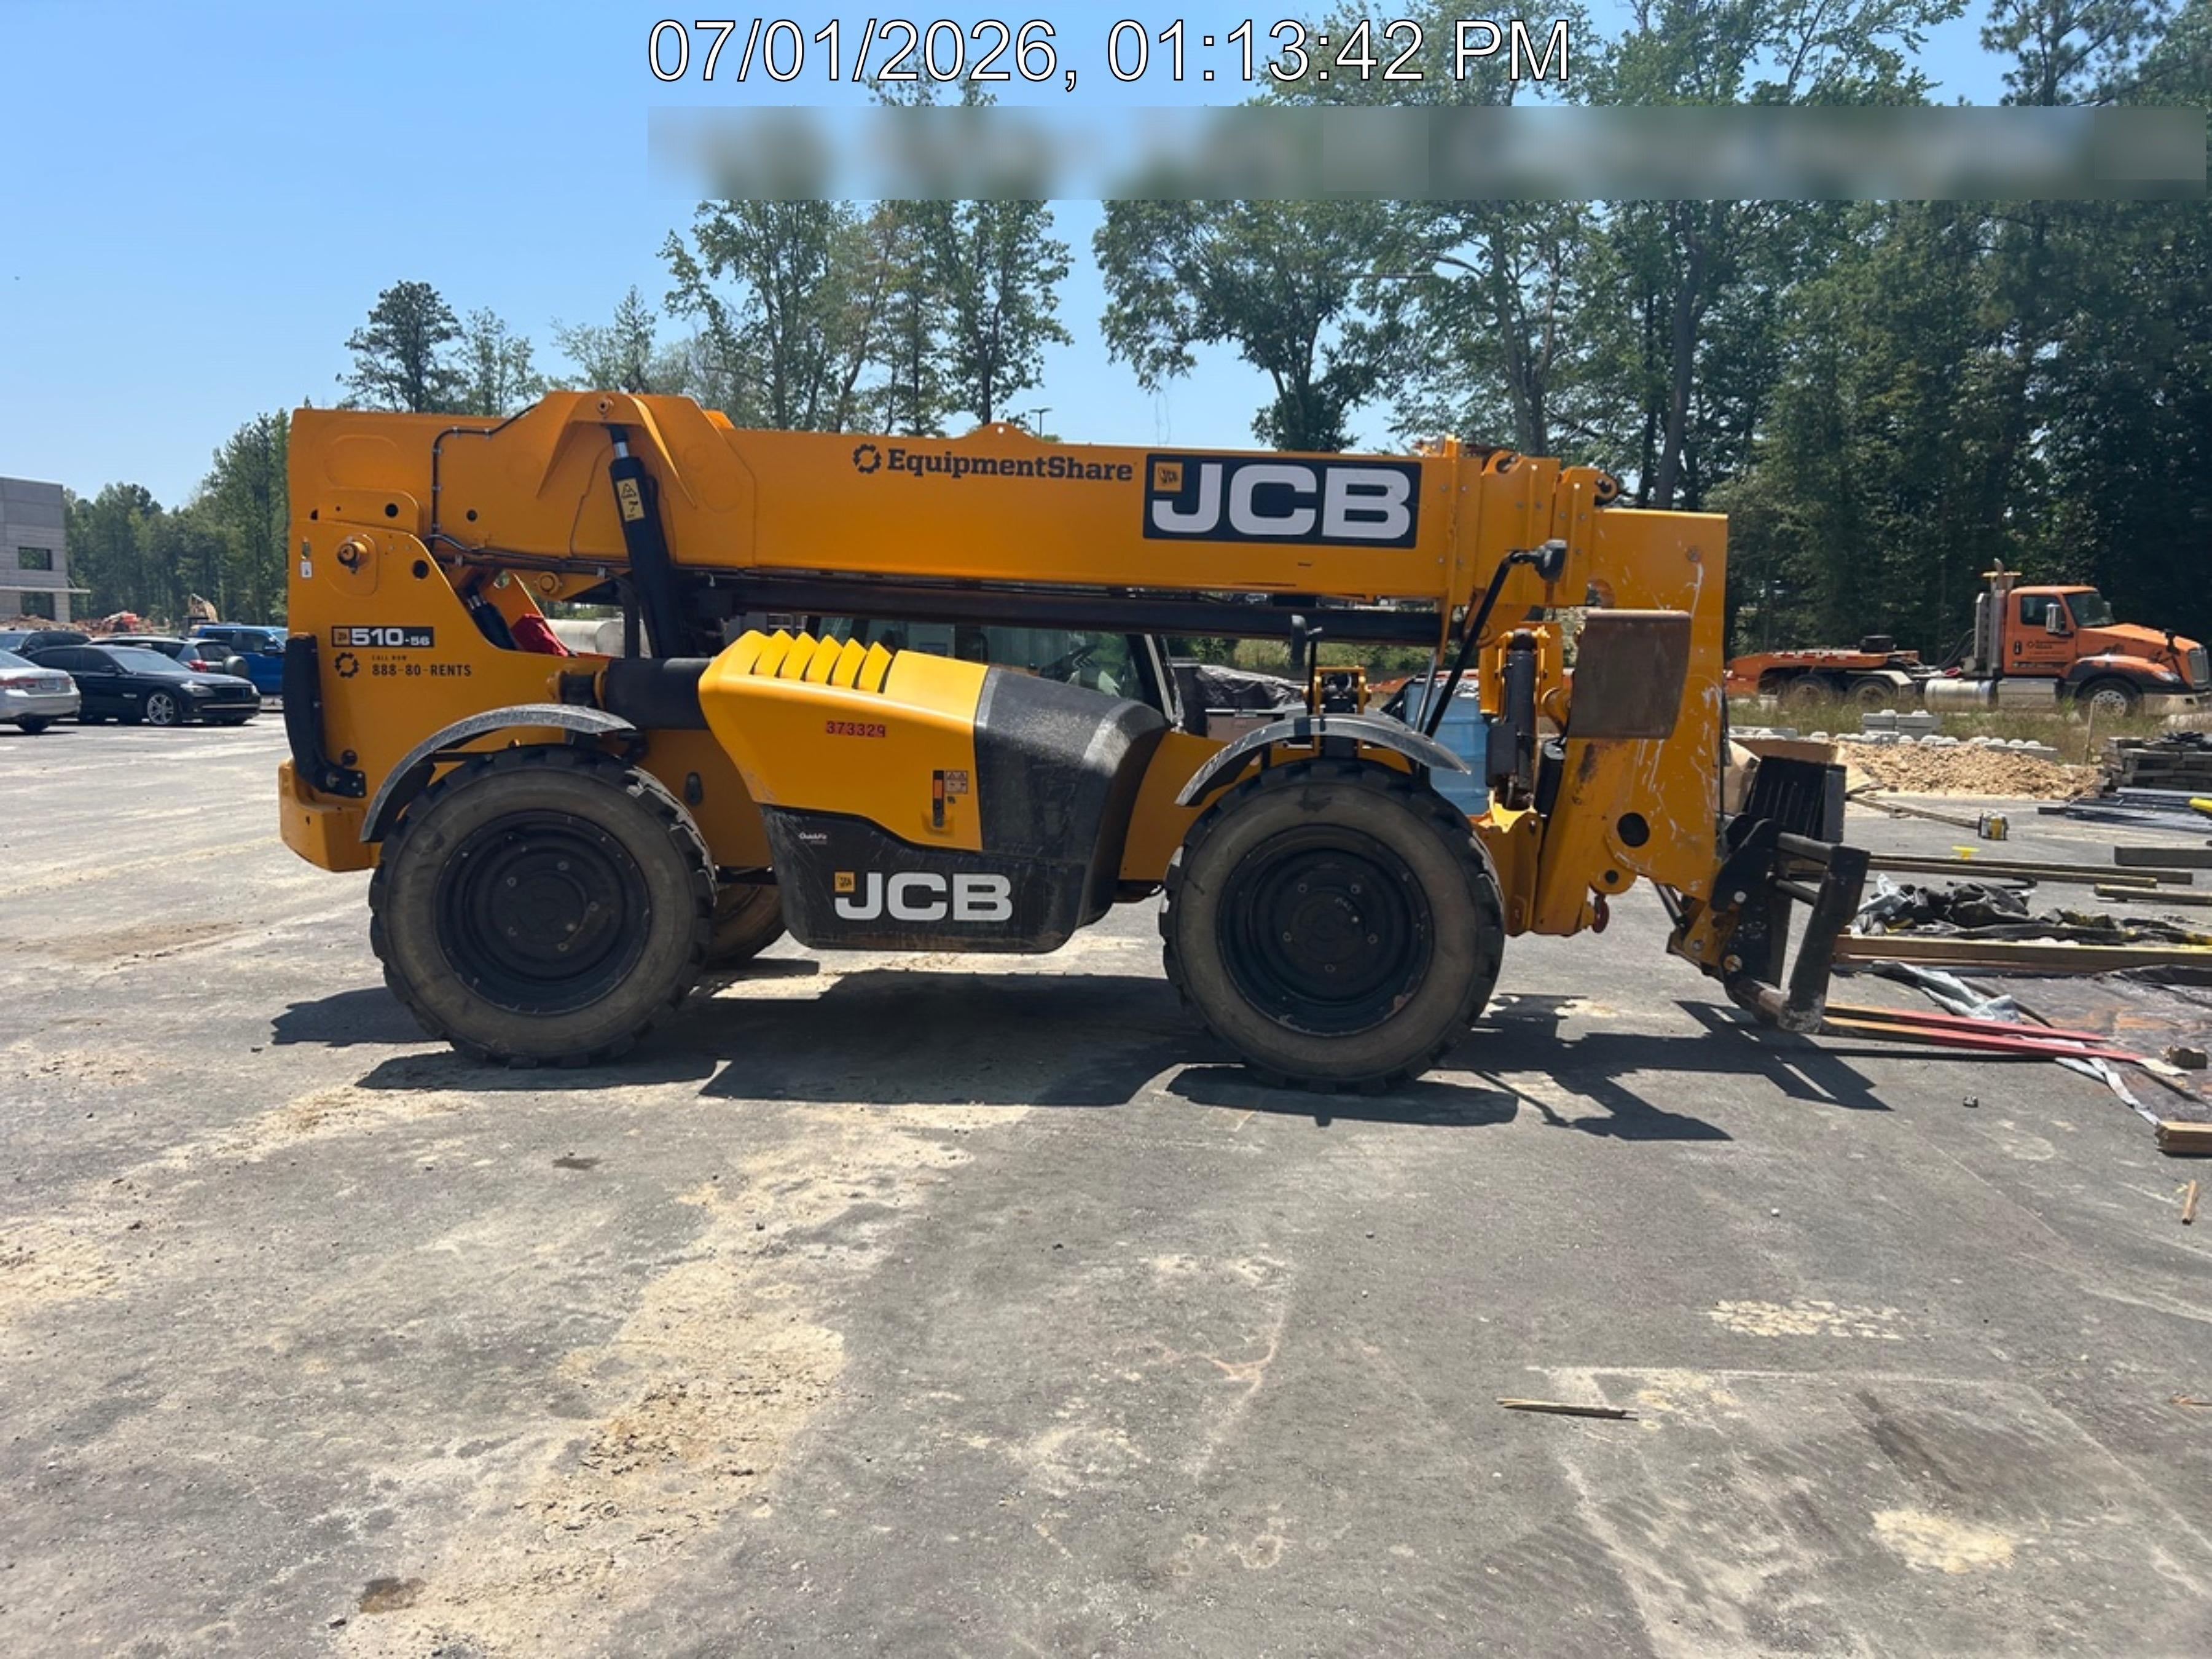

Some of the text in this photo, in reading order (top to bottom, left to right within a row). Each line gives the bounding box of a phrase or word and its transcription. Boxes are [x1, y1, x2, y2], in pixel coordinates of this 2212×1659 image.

[887, 449, 1133, 480] EquipmentShare
[1151, 463, 1411, 539] JCB
[351, 628, 430, 646] 510-56
[372, 664, 472, 677] 888-80-RENTS
[826, 720, 886, 738] 373329
[834, 871, 1013, 921] JCB
